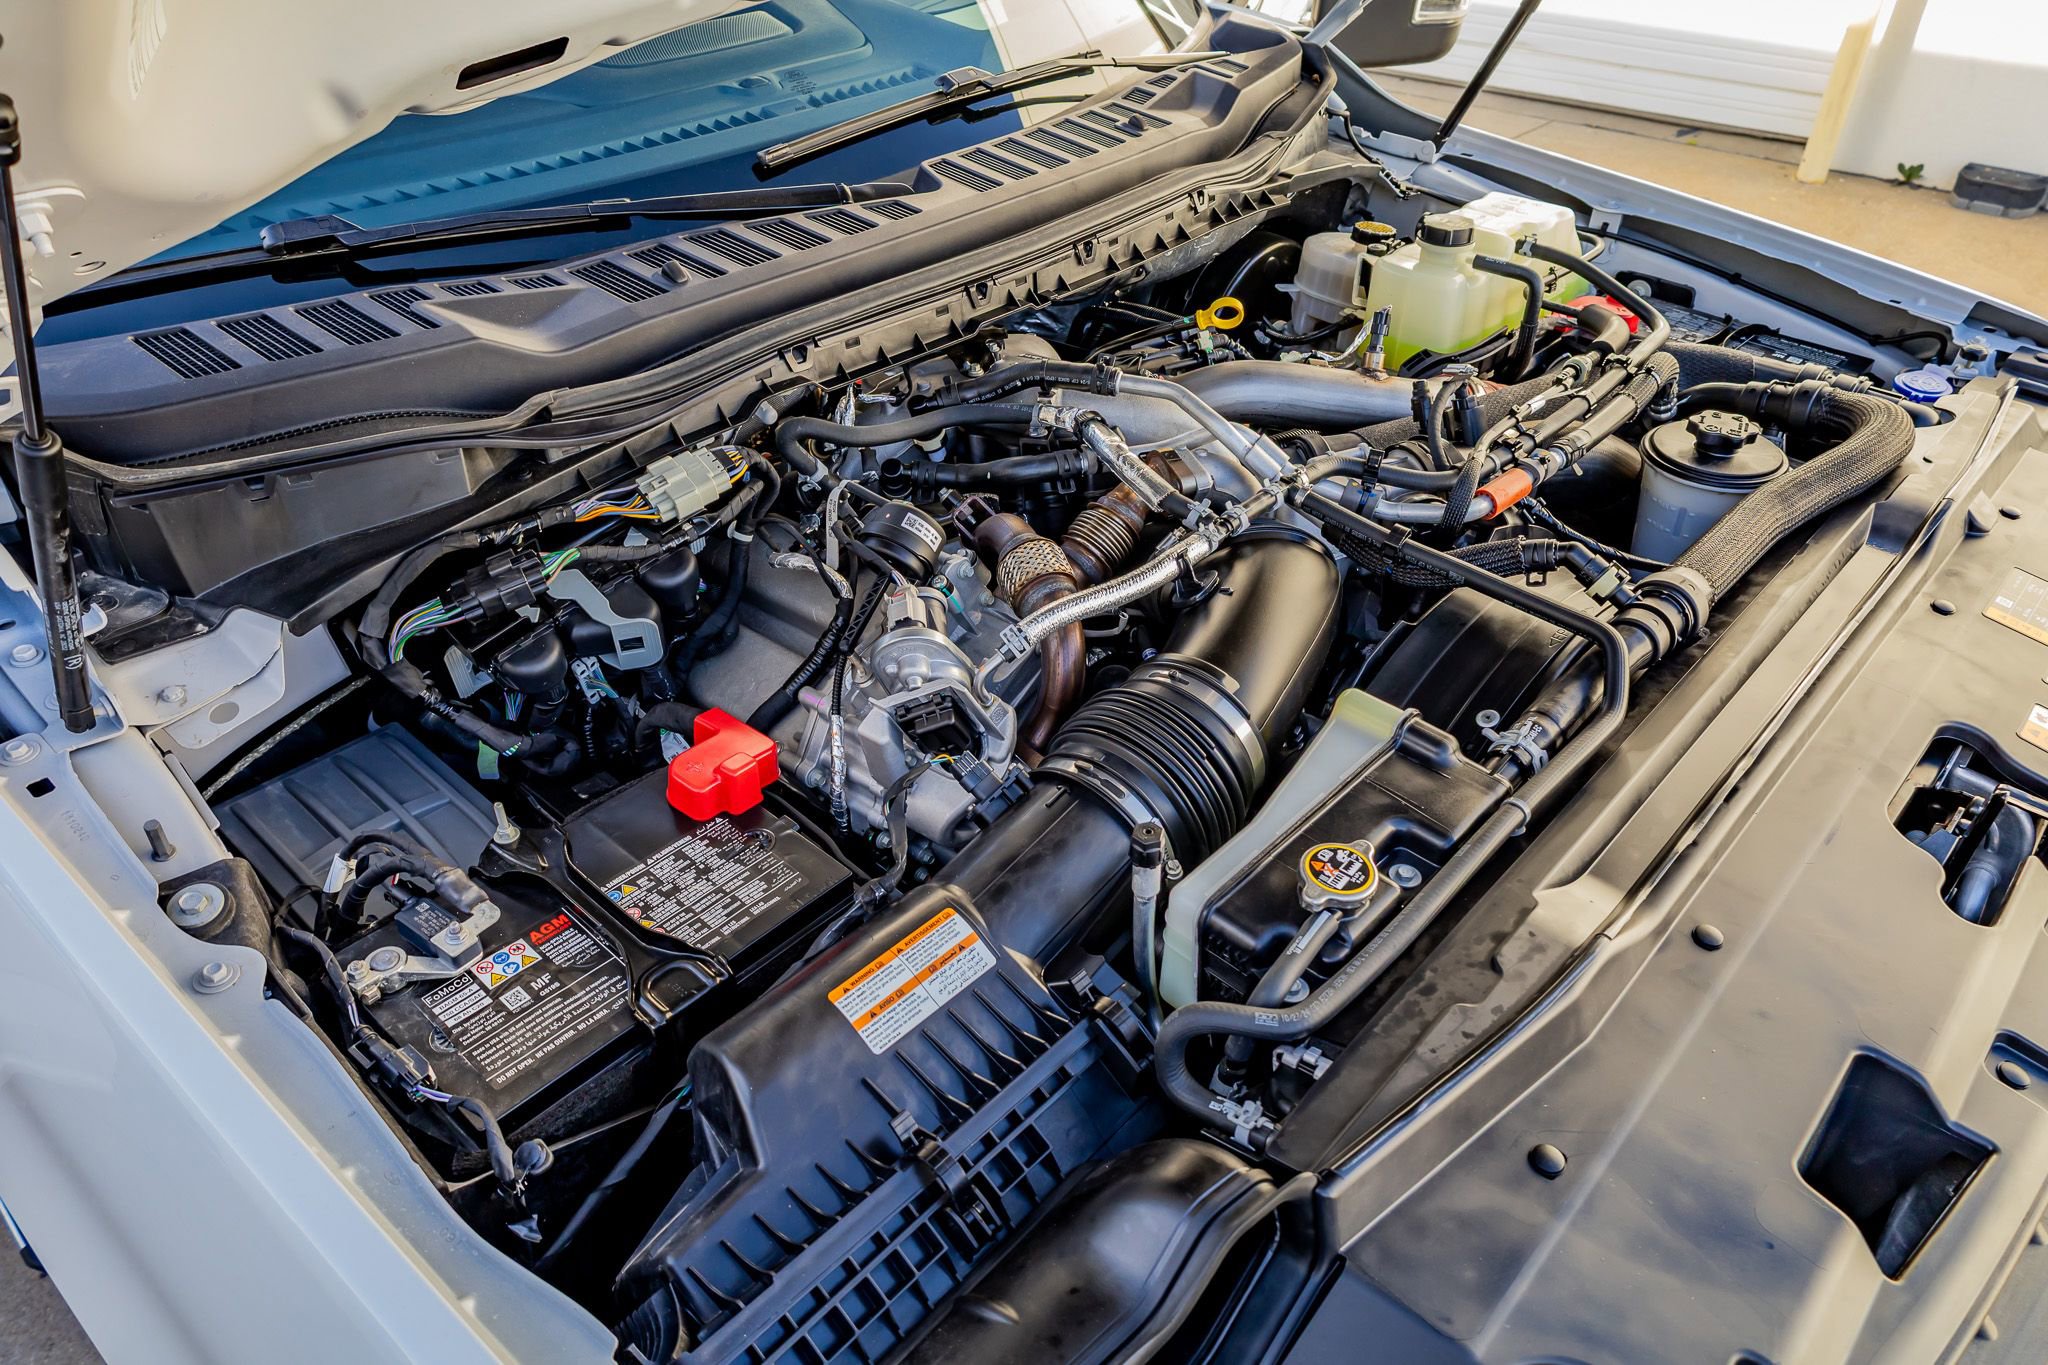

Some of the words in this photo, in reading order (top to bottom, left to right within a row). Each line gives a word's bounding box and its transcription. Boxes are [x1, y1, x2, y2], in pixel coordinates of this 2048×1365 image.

[527, 914, 571, 944] AGM
[539, 927, 575, 952] NON-SPILLABLE
[904, 917, 944, 948] AVERTISSEMENT
[937, 949, 959, 967] تحذير
[530, 972, 555, 991] MF
[615, 979, 629, 990] صنع
[849, 967, 875, 988] WARNING
[425, 974, 470, 1006] FoMoCo
[589, 989, 612, 1006] الولايات
[454, 991, 484, 1013] CCA/SAE
[878, 995, 896, 1011] AVISO
[576, 1022, 588, 1031] NO
[585, 1017, 596, 1026] LA
[592, 1007, 611, 1022] ABRA.
[459, 1032, 472, 1043] Ford
[470, 1024, 485, 1036] Motor
[462, 1028, 487, 1047] Dearborn,
[472, 1046, 486, 1057] Made
[489, 1037, 501, 1046] USA
[499, 1030, 511, 1040] with
[514, 1021, 525, 1029] and
[523, 1009, 543, 1024] imported
[535, 1050, 546, 1059] NE
[543, 1043, 556, 1054] PAS
[554, 1028, 579, 1047] OUVRIR.
[496, 1074, 507, 1084] DO
[505, 1067, 519, 1079] NOT
[517, 1056, 536, 1072] OPEN.
